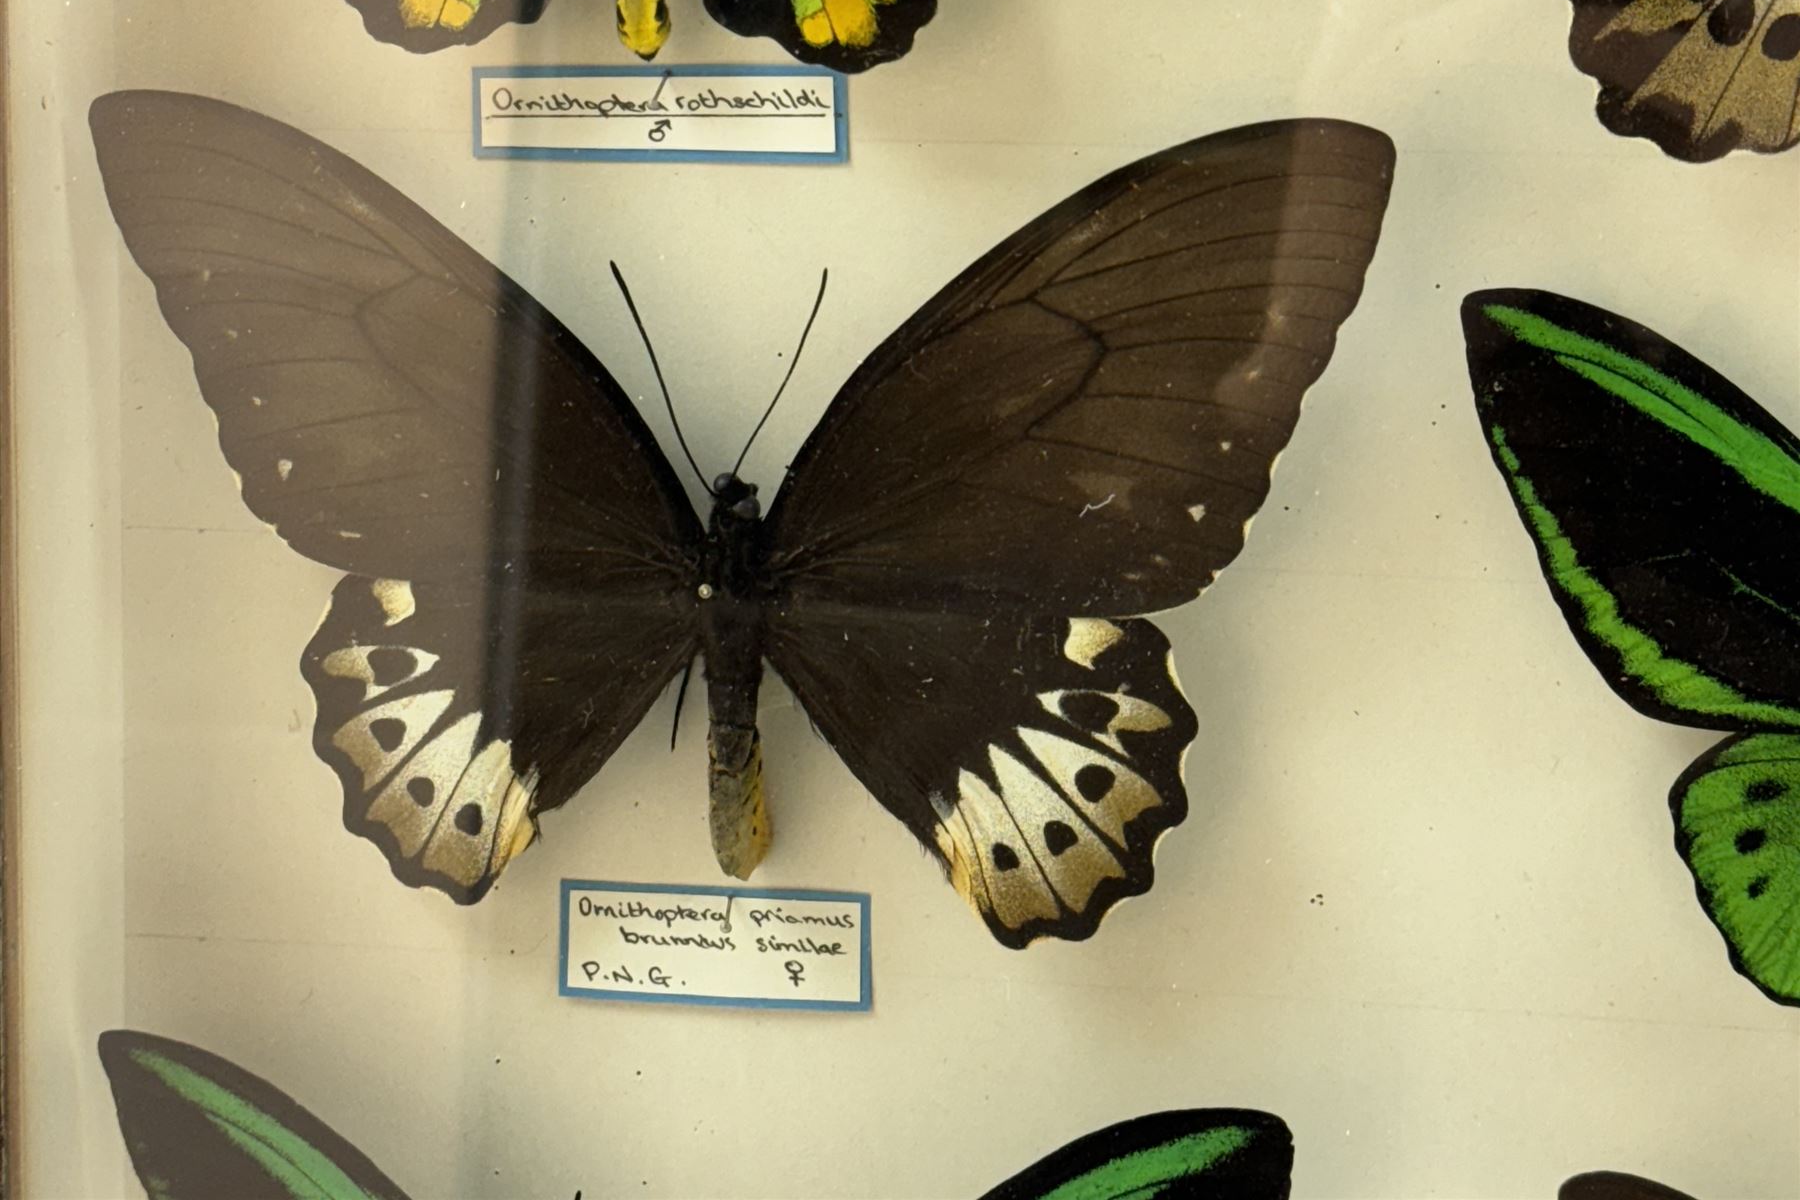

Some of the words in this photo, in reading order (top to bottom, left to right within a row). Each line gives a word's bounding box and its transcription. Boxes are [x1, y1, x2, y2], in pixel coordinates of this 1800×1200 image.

[676, 89, 831, 112] rothschildi
[578, 896, 728, 928] Ornithoptera
[749, 907, 855, 928] priamus
